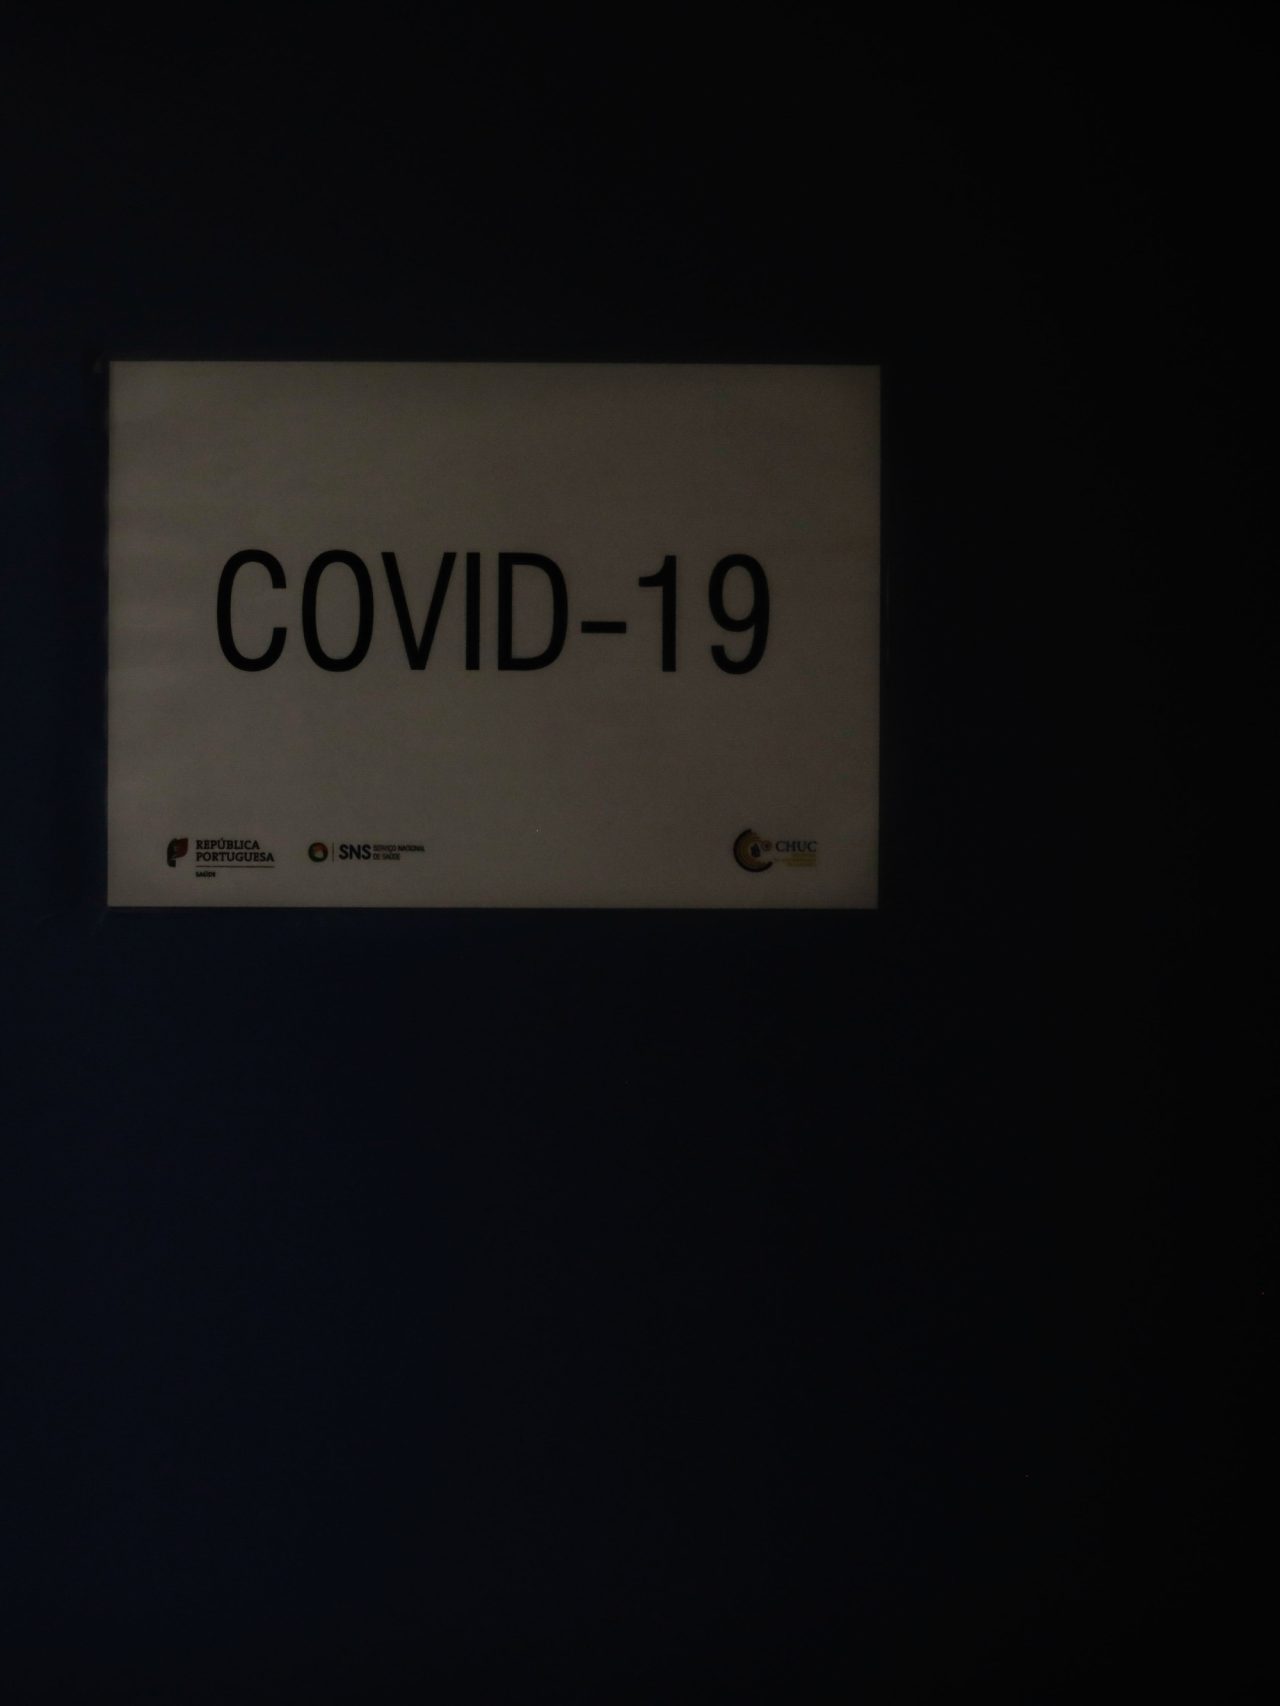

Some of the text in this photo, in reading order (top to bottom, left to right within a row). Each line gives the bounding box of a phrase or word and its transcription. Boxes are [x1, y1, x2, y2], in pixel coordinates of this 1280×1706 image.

[216, 549, 771, 675] COVID-19
[196, 837, 260, 850] REPÚBLICA
[775, 840, 817, 852] CHUC
[196, 851, 275, 862] PORTUGUESA
[339, 844, 372, 860] SNS
